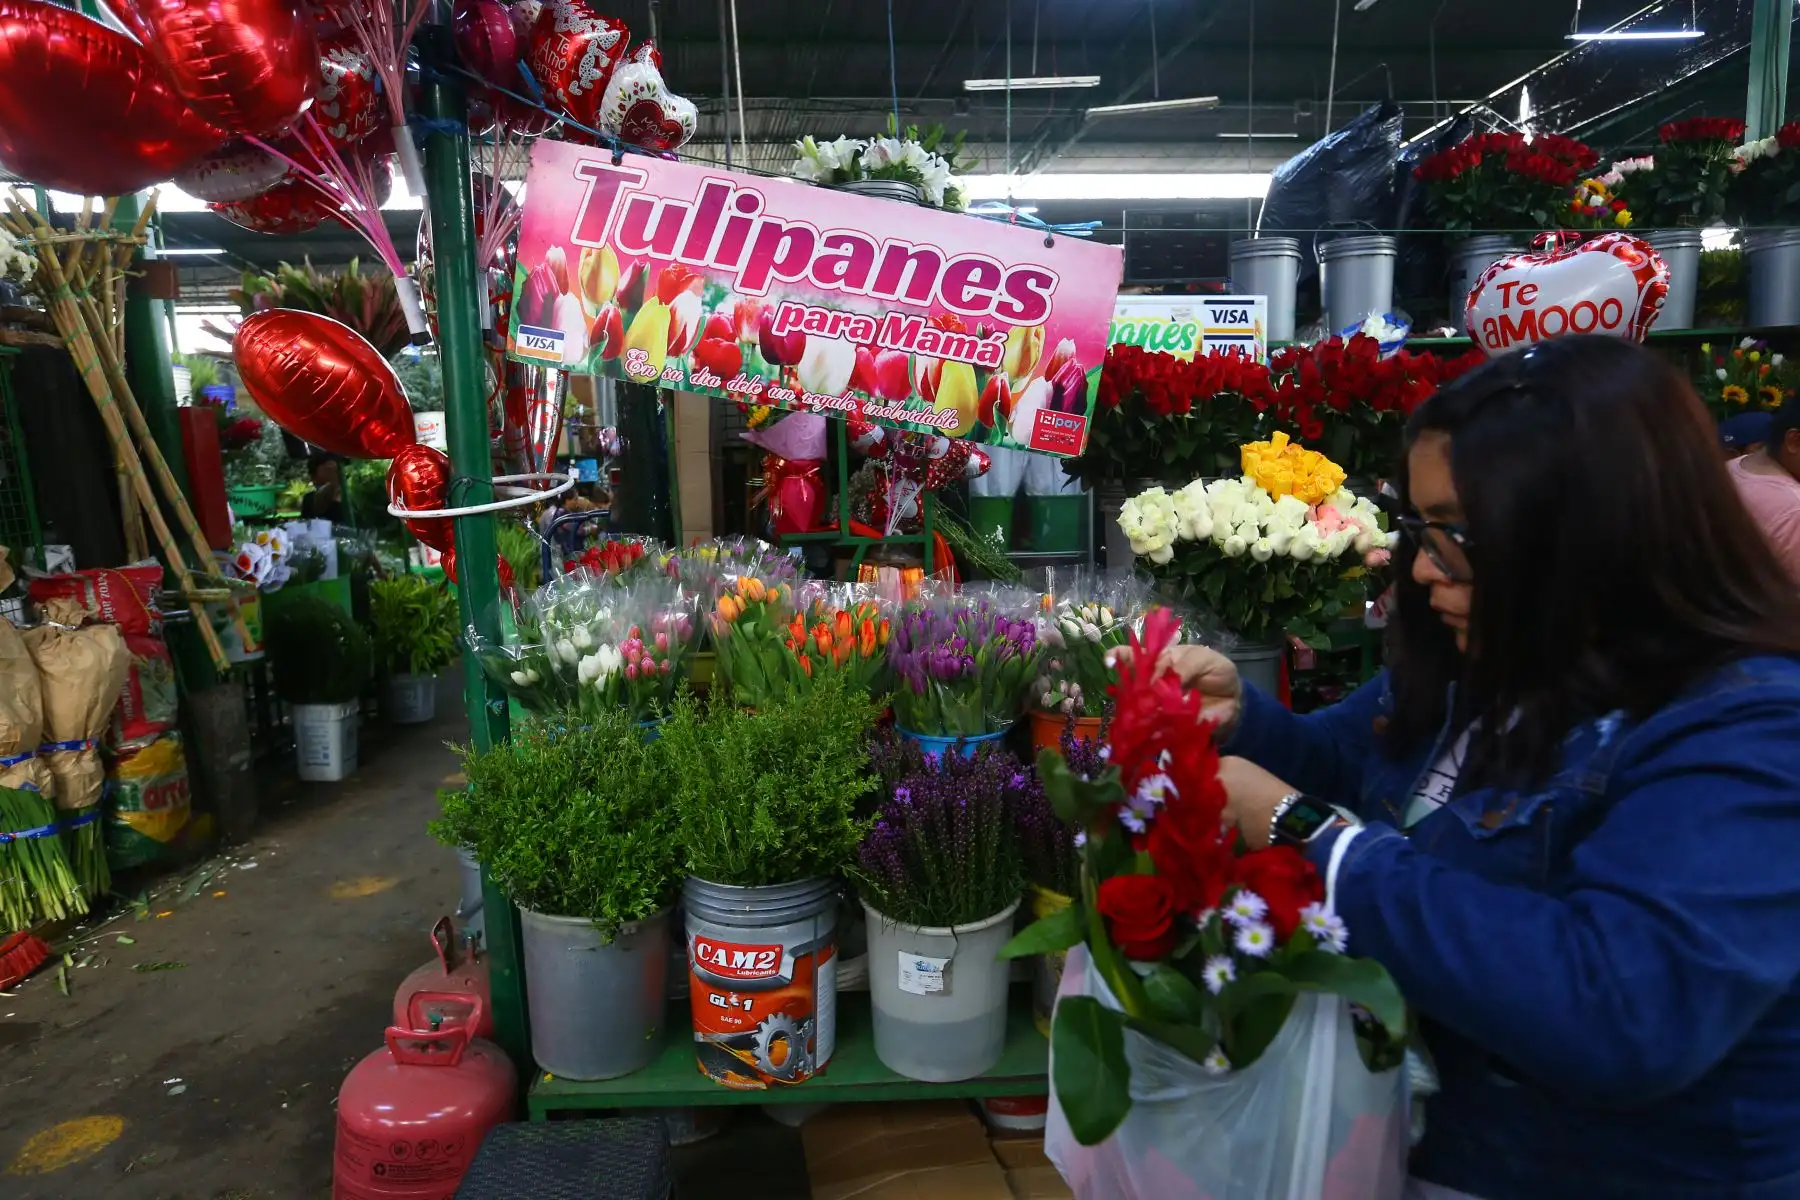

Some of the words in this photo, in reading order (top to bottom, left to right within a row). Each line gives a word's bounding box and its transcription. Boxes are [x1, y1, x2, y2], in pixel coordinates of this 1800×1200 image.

[541, 39, 568, 70] Amo
[557, 33, 570, 54] Te
[573, 160, 1058, 325] Tulipanes
[1497, 281, 1538, 308] Te
[1210, 310, 1249, 324] VISA
[526, 336, 555, 350] VISA
[773, 303, 876, 342] para
[879, 311, 1008, 367] Mamá
[625, 349, 656, 377] En
[661, 367, 684, 382] su
[727, 373, 763, 394] dele
[768, 387, 796, 401] un
[802, 391, 857, 412] regalo
[862, 400, 959, 429] inolvidable
[1040, 412, 1081, 431] izipay
[698, 943, 776, 969] CAM2
[721, 1016, 733, 1024] SAE
